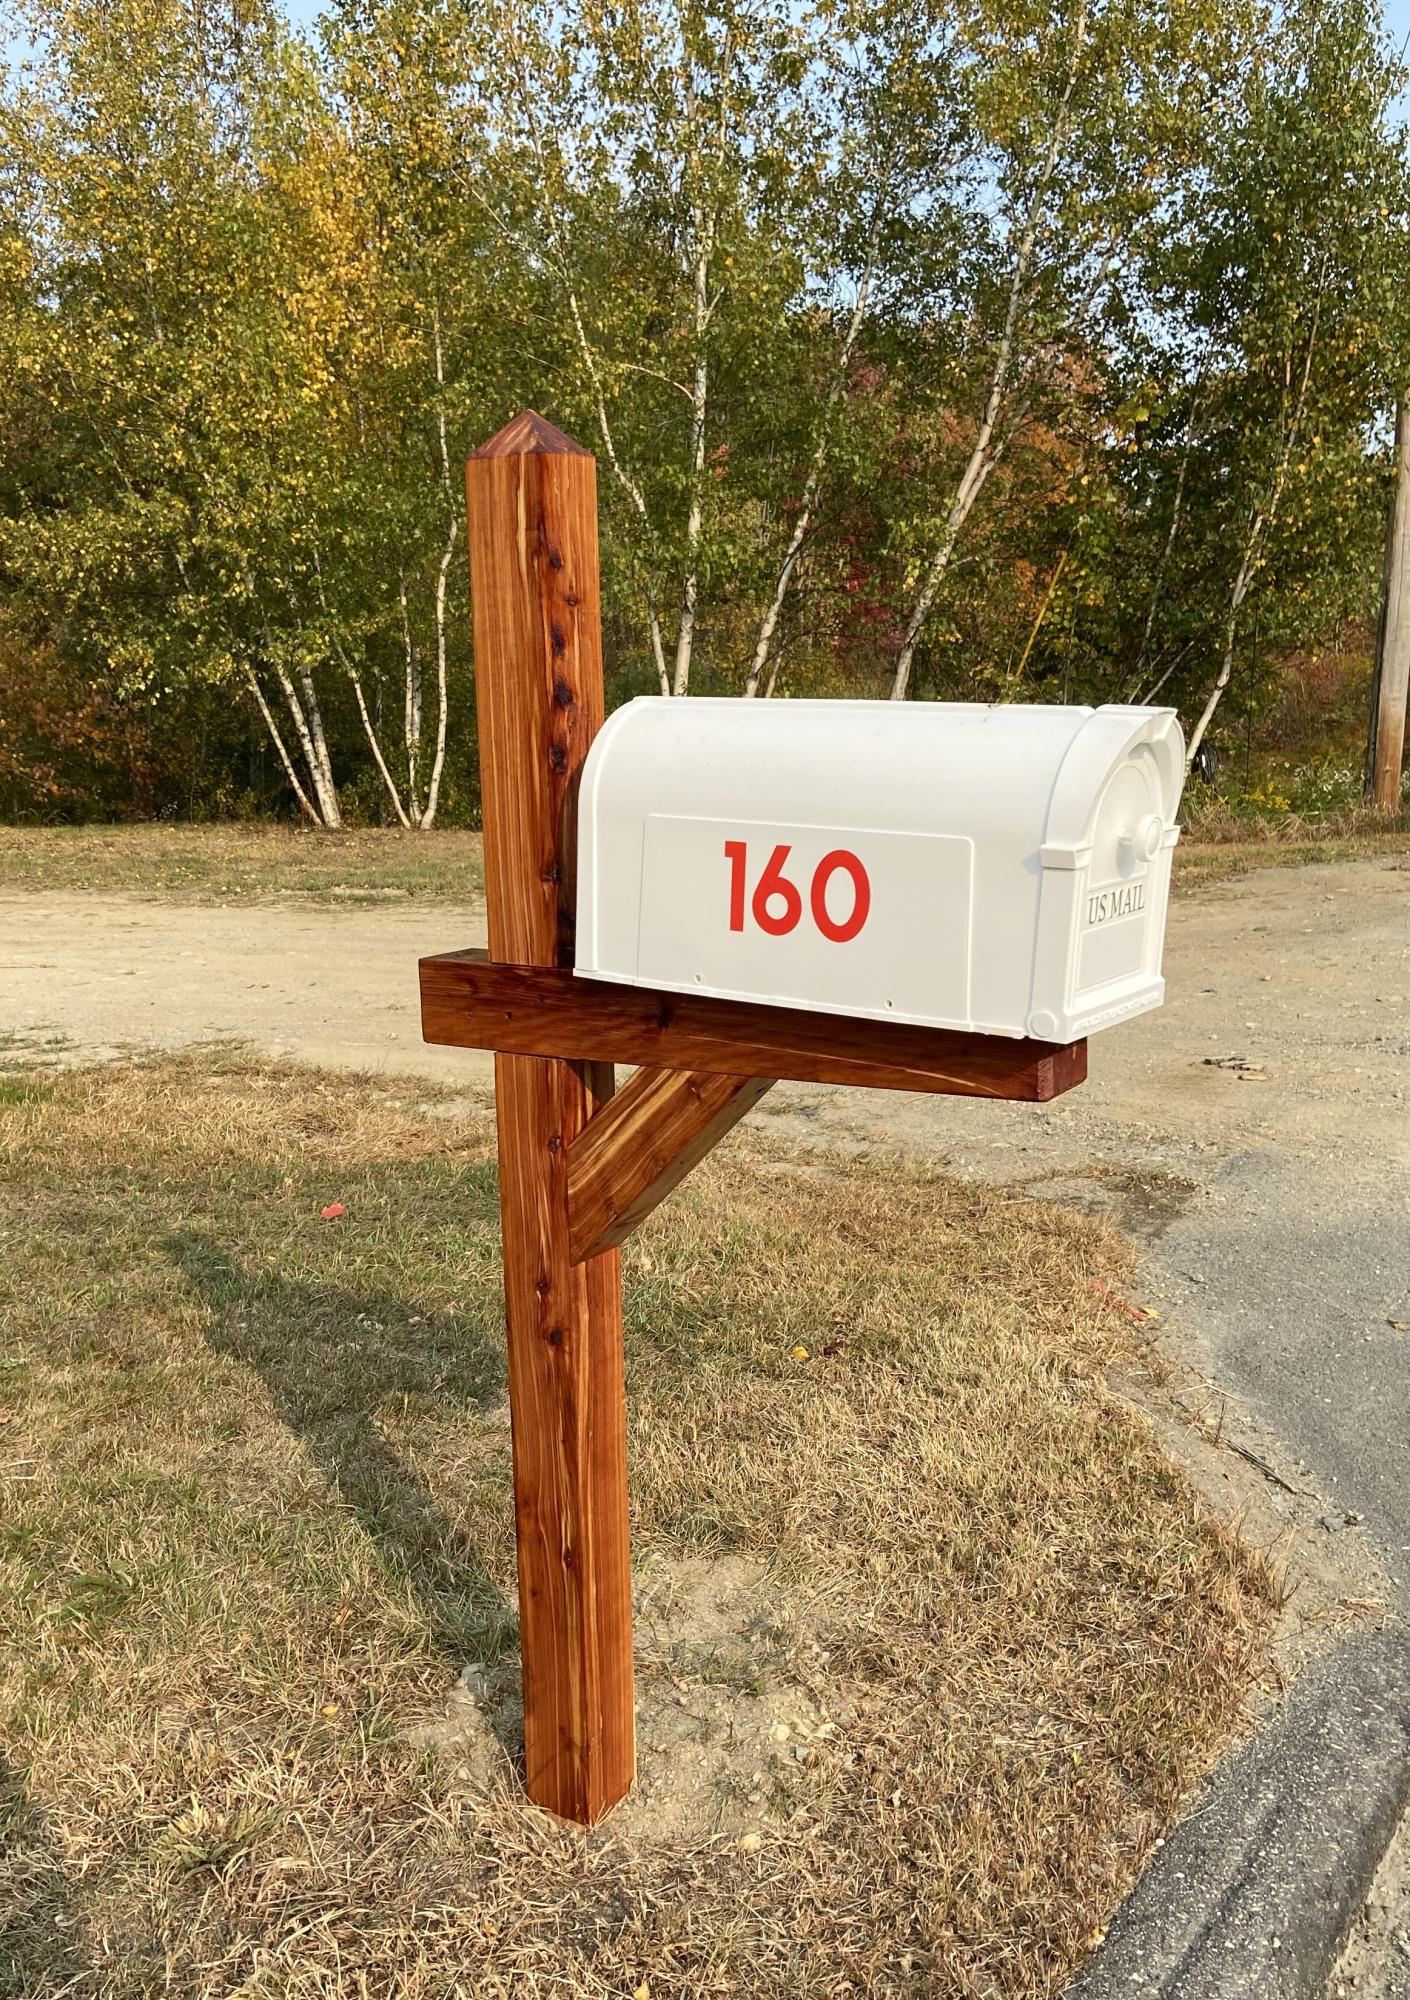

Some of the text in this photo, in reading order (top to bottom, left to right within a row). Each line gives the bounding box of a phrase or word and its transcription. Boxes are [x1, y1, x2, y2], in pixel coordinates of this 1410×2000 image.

[724, 840, 871, 943] 160
[1088, 884, 1145, 925] US MAIL
